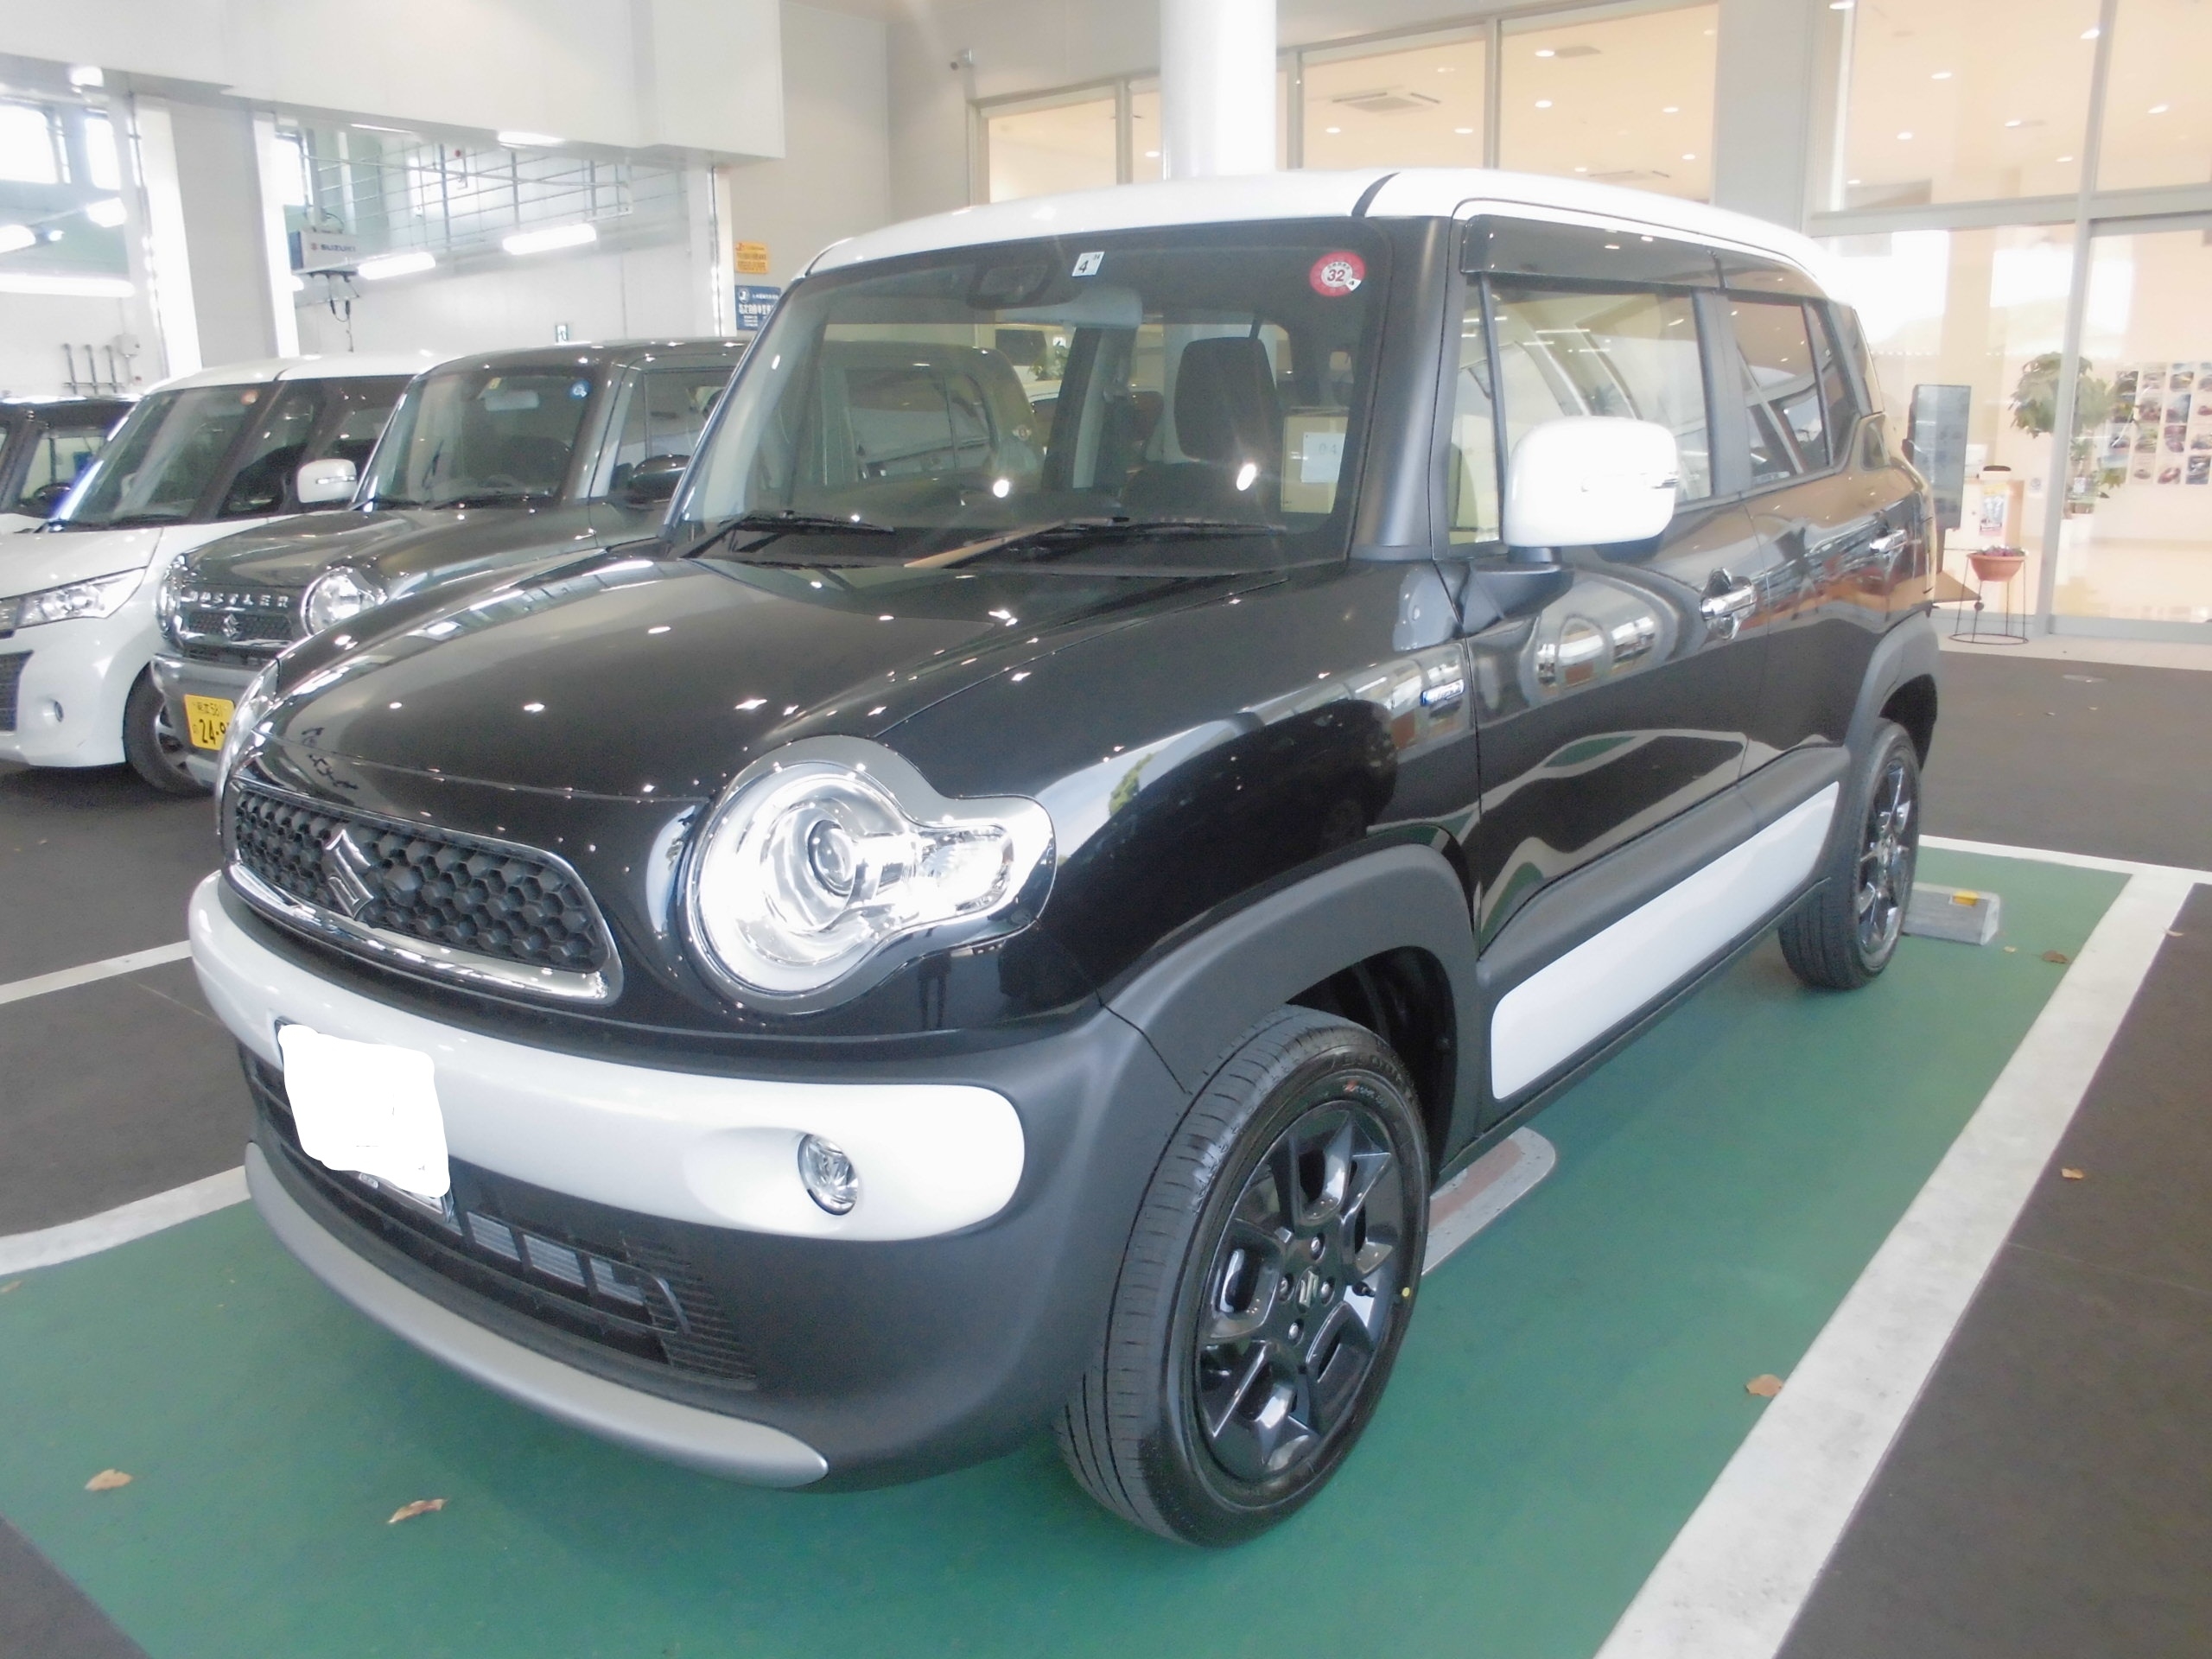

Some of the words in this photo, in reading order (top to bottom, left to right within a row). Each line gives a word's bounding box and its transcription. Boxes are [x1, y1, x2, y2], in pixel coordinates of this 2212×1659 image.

[321, 244, 356, 252] SUZUKI
[1078, 260, 1089, 273] 4
[1327, 269, 1345, 282] 32
